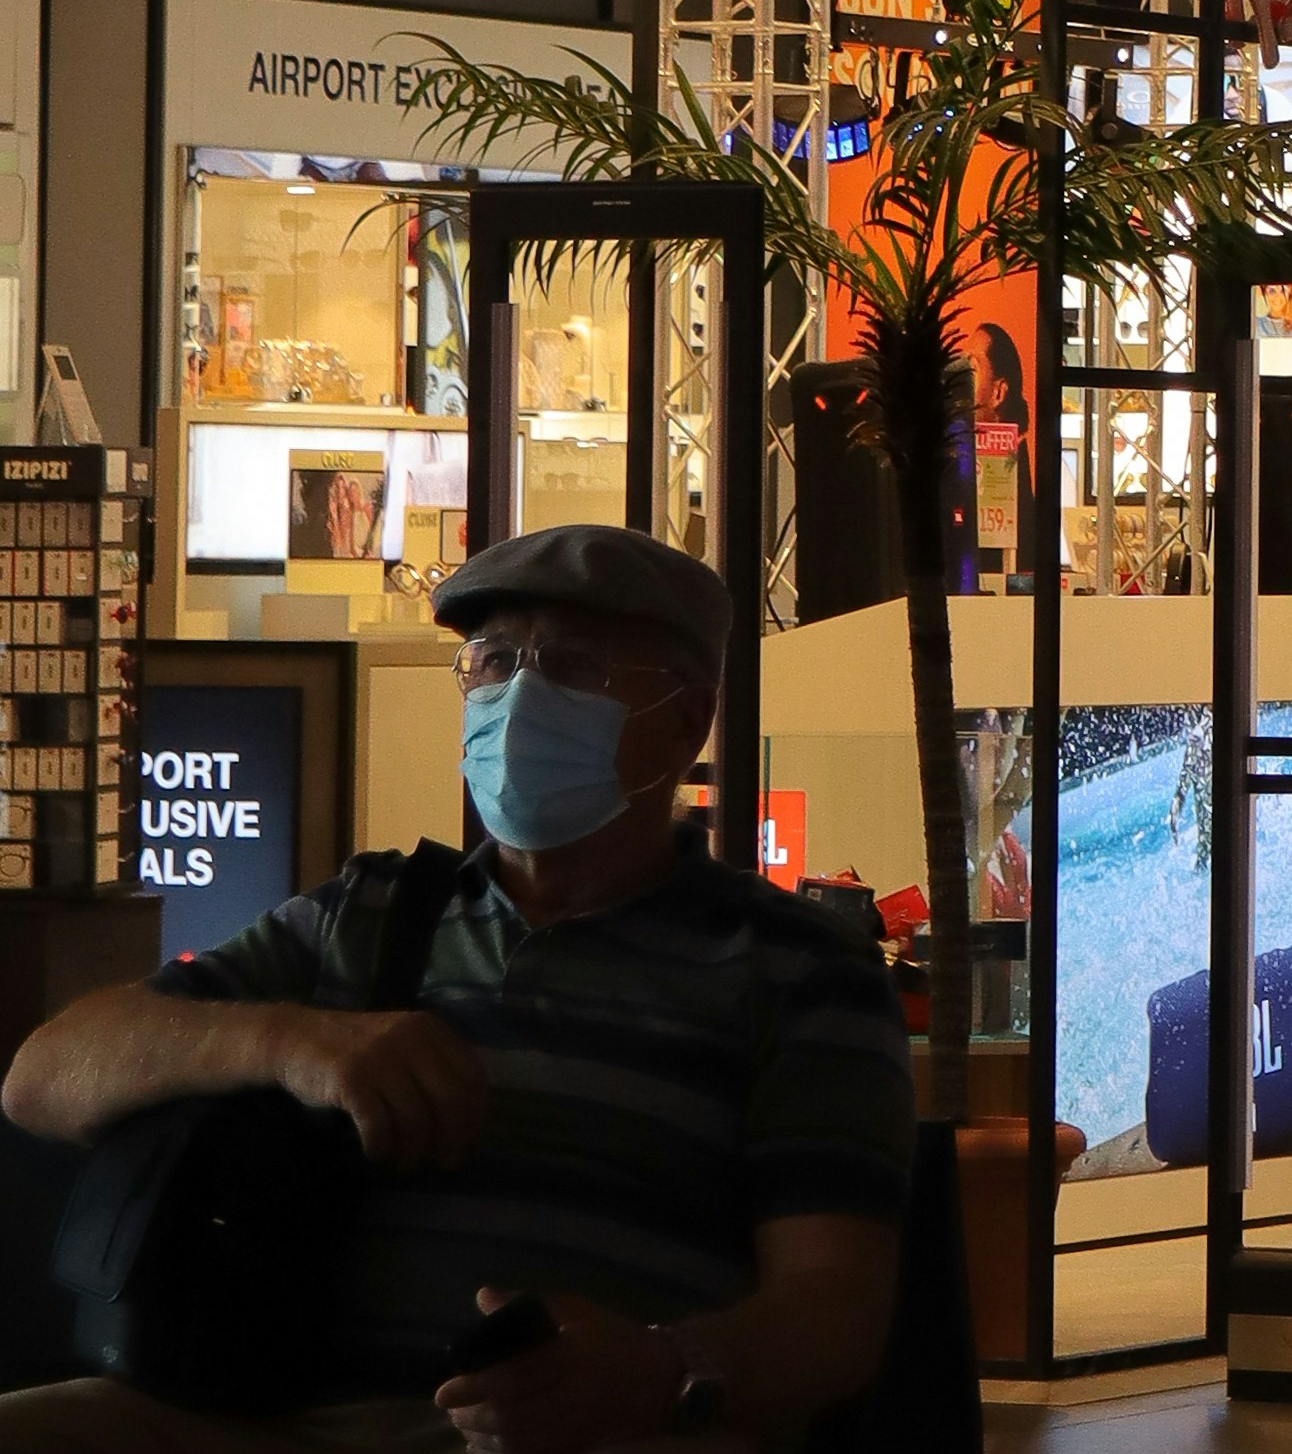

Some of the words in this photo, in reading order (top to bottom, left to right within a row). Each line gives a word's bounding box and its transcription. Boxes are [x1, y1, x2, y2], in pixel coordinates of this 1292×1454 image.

[248, 51, 386, 103] AIRPORT
[4, 460, 68, 481] IZIPIZI
[141, 798, 261, 838] USIVE
[139, 847, 215, 887] ALS
